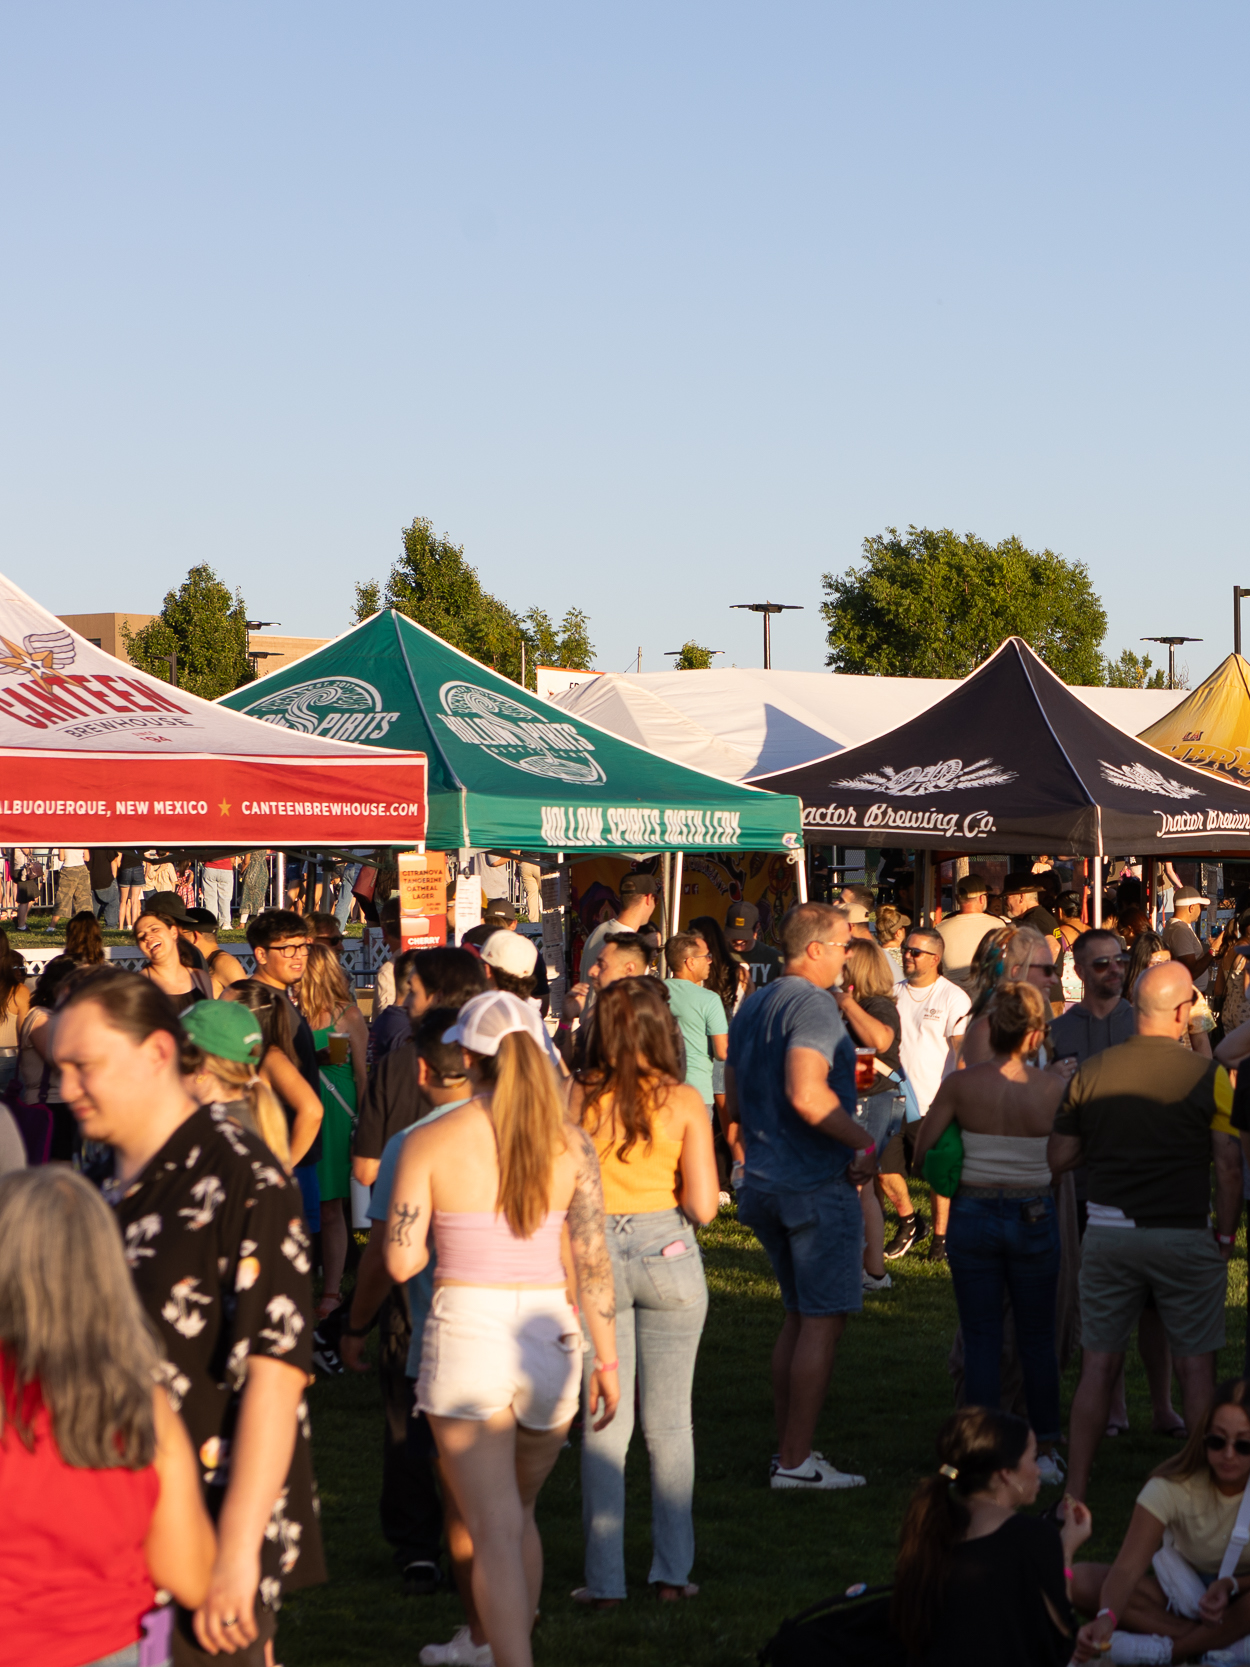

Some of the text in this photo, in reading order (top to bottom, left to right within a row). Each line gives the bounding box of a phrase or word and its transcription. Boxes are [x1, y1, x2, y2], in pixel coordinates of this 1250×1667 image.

[0, 675, 192, 729] CANTEEN
[64, 717, 194, 738] BREWHOUSE
[115, 801, 149, 815] NEW
[153, 801, 208, 815] MEXICO
[241, 801, 418, 816] CANTEENBREWHOUSE.COM
[540, 806, 742, 846] HOLLOW SPIRITS DISTILLERY
[803, 803, 997, 838] actor Brewing Co.
[1153, 810, 1204, 838] Tractor
[407, 936, 440, 946] CHERRY
